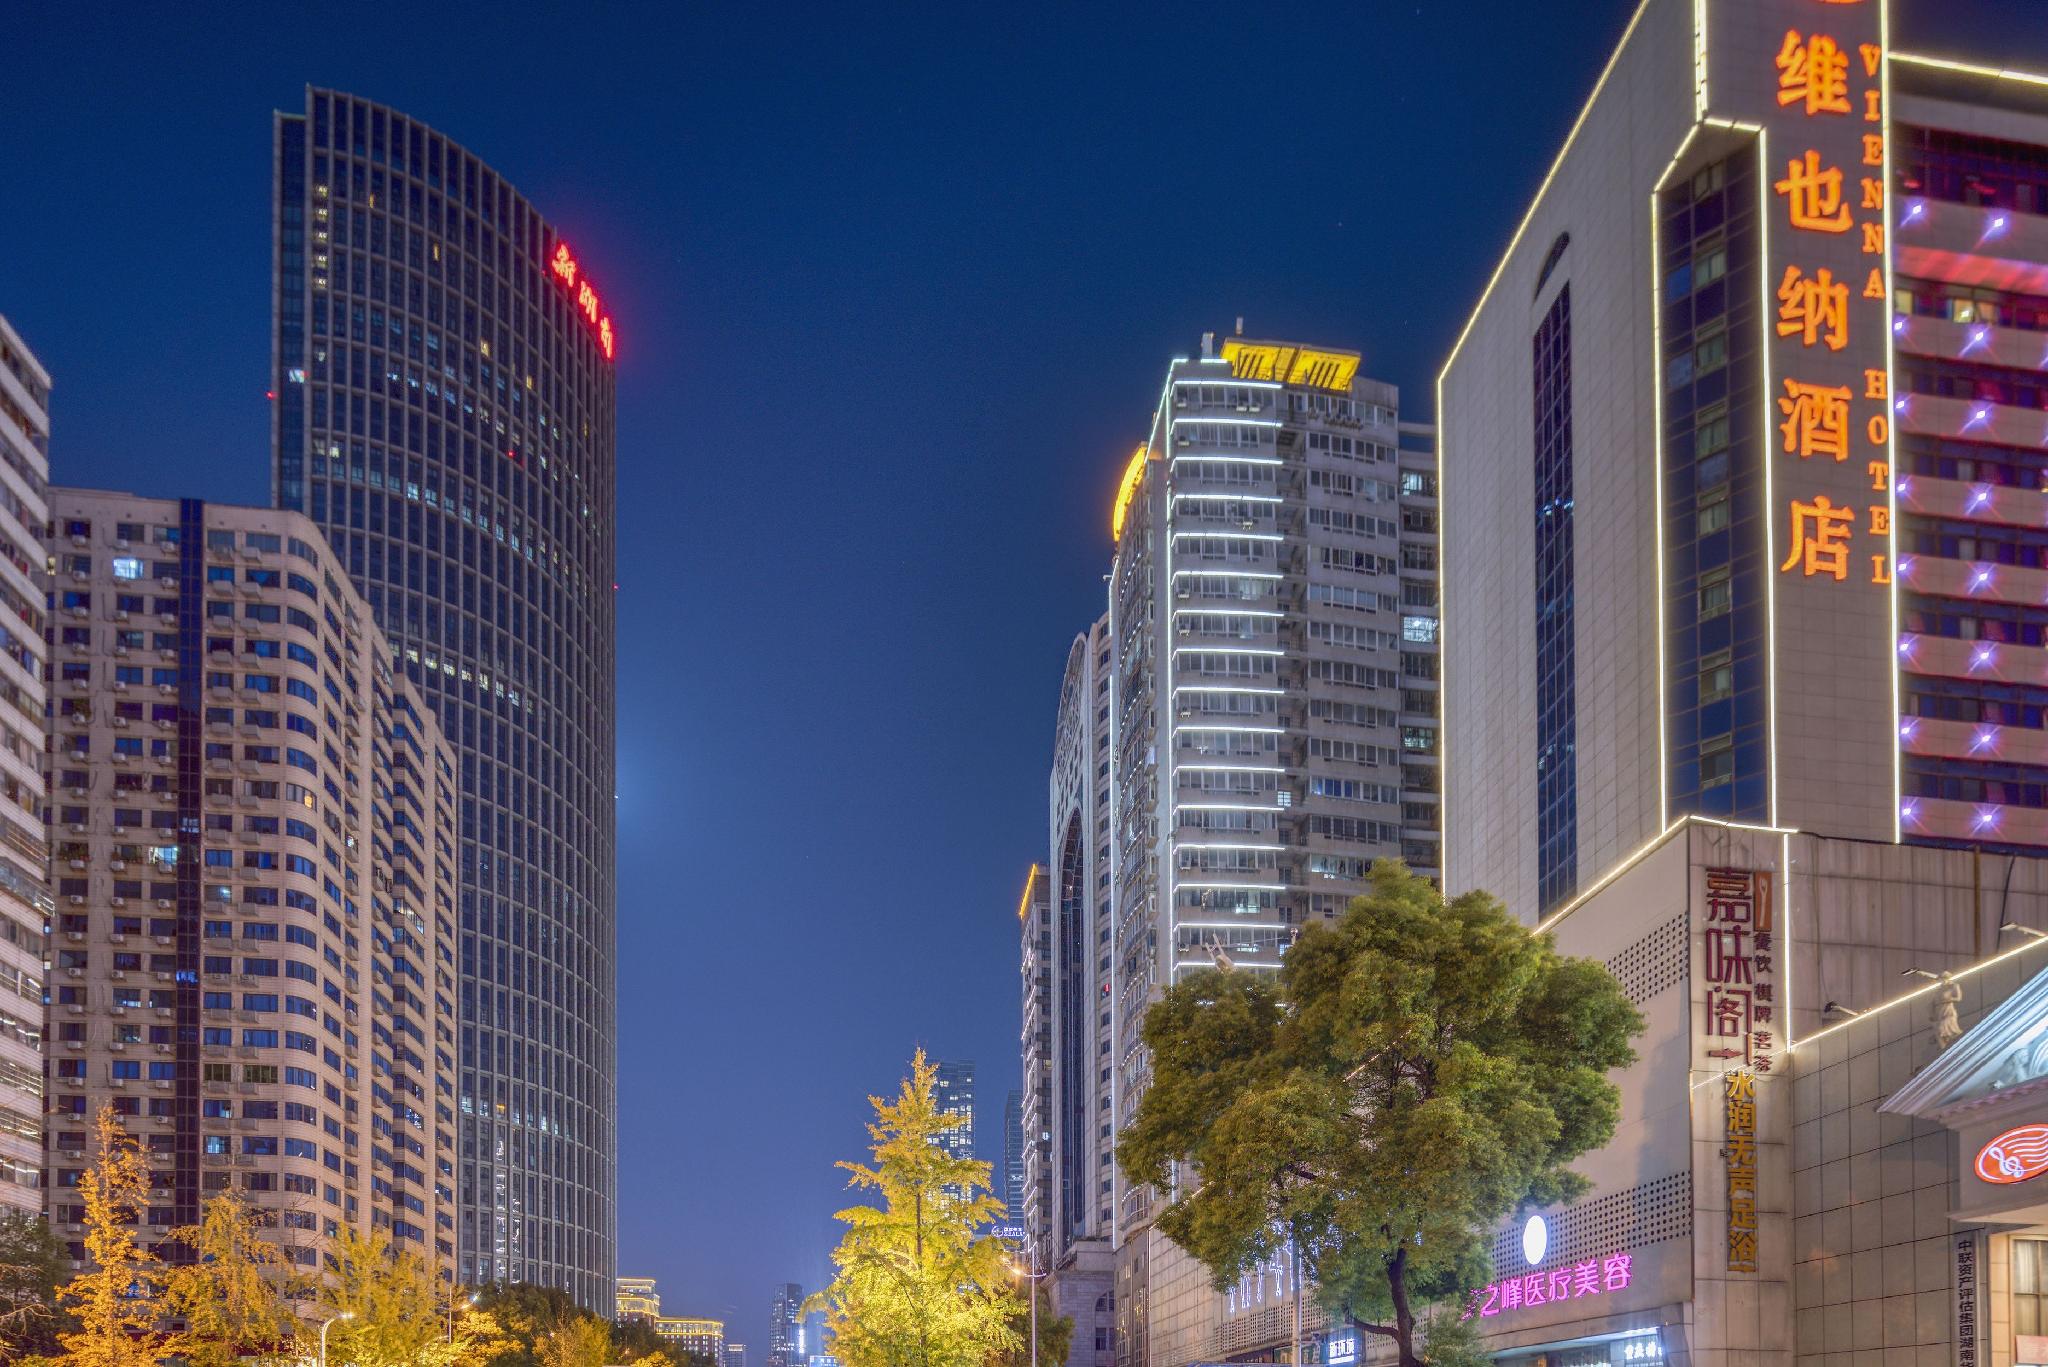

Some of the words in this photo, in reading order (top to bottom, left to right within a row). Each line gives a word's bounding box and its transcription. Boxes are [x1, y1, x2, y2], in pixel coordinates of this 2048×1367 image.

[1858, 43, 1885, 299] VIENNA
[1775, 29, 1855, 582] 维也纳酒店
[1864, 369, 1891, 585] HOTEL
[1706, 866, 1753, 1066] 嘉味阁
[1727, 1070, 1757, 1264] 水润无声足浴
